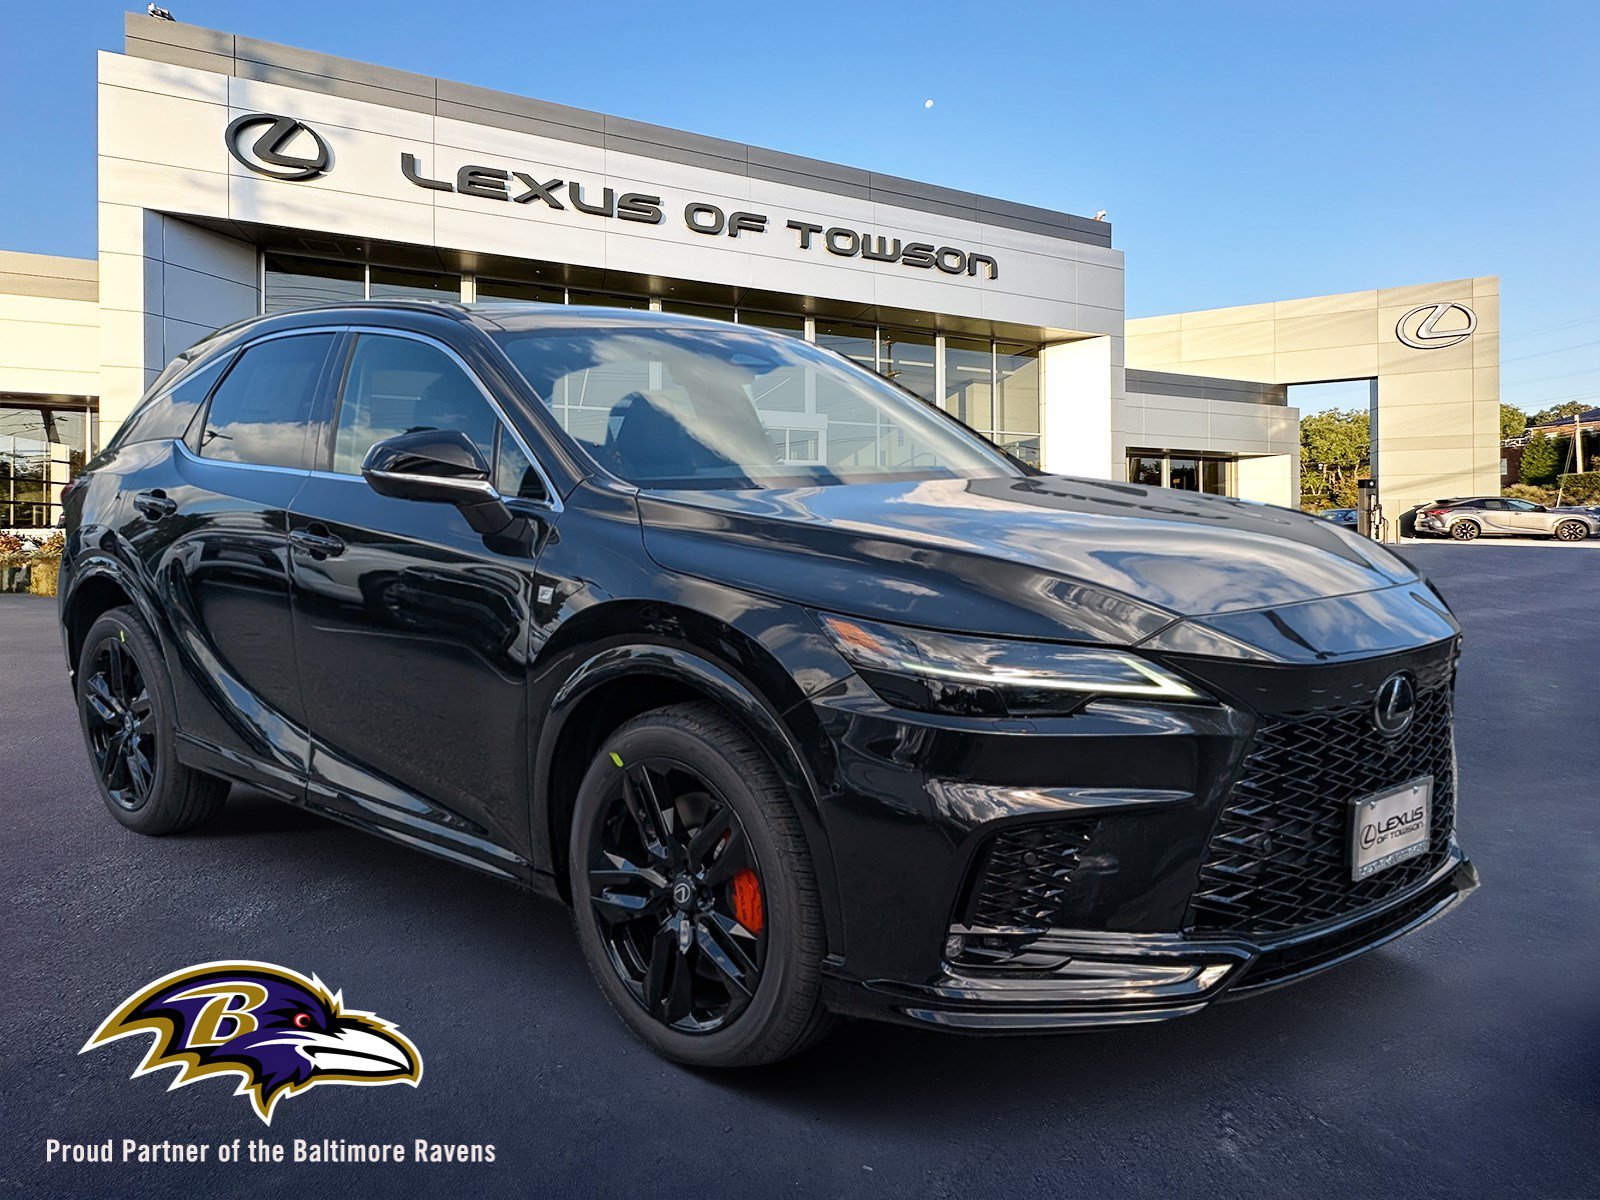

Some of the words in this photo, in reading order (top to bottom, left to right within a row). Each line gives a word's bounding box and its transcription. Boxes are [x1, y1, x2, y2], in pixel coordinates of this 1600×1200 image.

[401, 152, 662, 224] LEXUS
[684, 202, 768, 238] OF
[786, 219, 999, 280] TOWSON
[1378, 806, 1424, 834] LEXUS
[1376, 833, 1389, 844] OF
